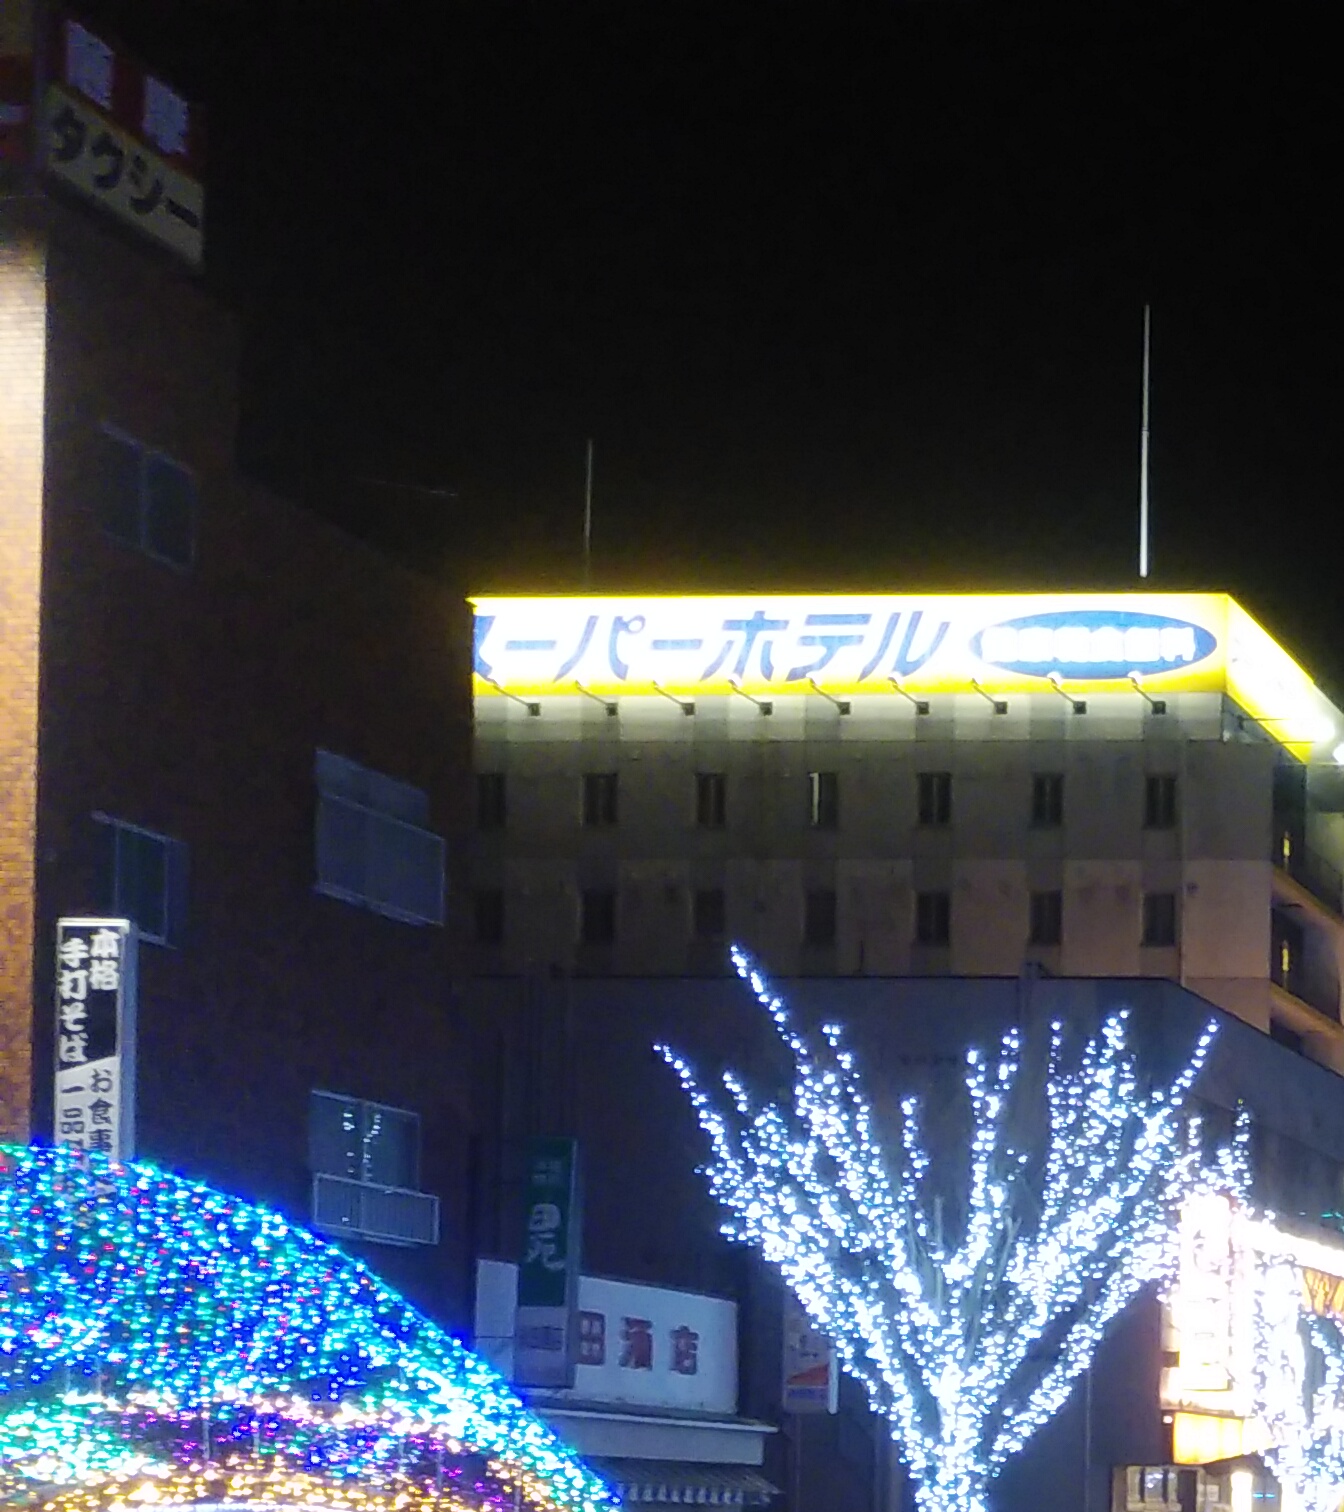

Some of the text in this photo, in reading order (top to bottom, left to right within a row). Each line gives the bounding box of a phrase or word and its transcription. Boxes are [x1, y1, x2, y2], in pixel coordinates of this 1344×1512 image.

[51, 105, 199, 228] タクシー
[59, 937, 89, 1063] 手打そば
[90, 928, 119, 990] 本格
